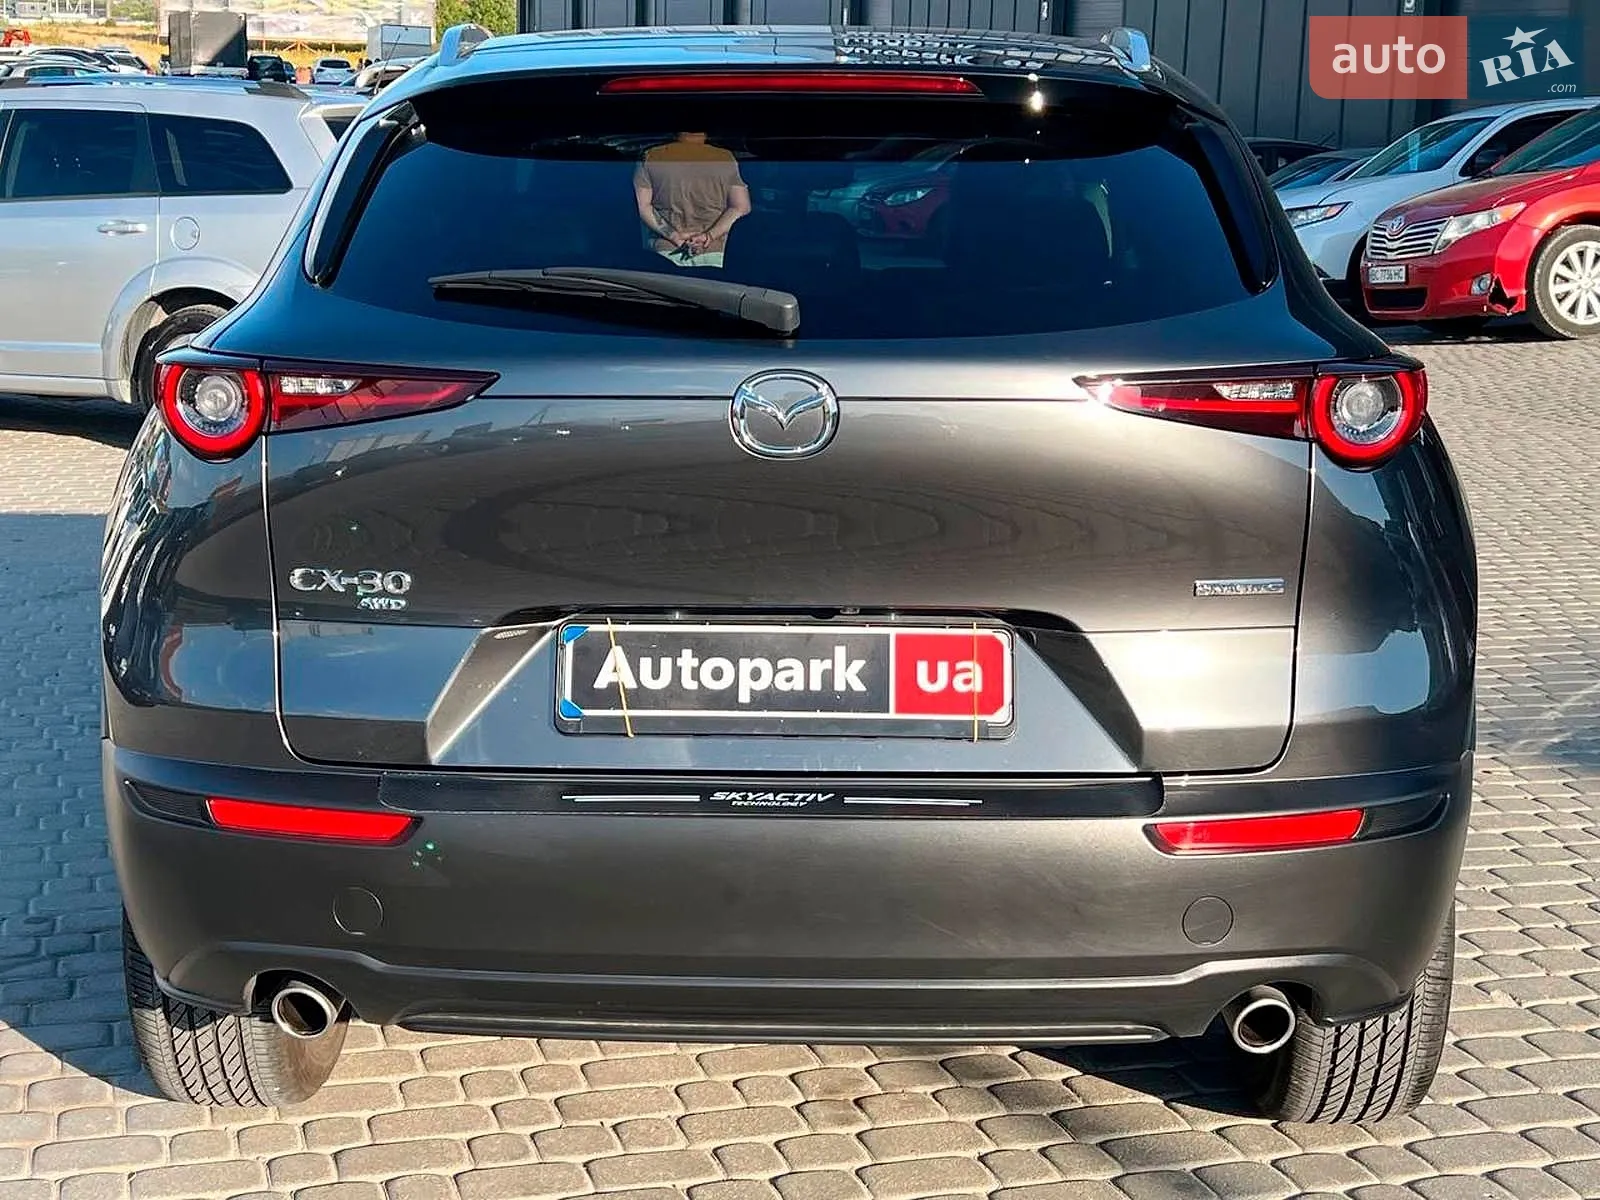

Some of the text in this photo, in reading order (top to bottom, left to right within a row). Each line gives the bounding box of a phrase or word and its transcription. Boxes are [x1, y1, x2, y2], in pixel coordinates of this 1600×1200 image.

[289, 568, 412, 594] CX-30
[357, 597, 407, 610] AWD
[593, 645, 983, 703] Autopark ua
[709, 791, 835, 802] SKYACTIV
[731, 800, 808, 808] TECHNOLOGY
